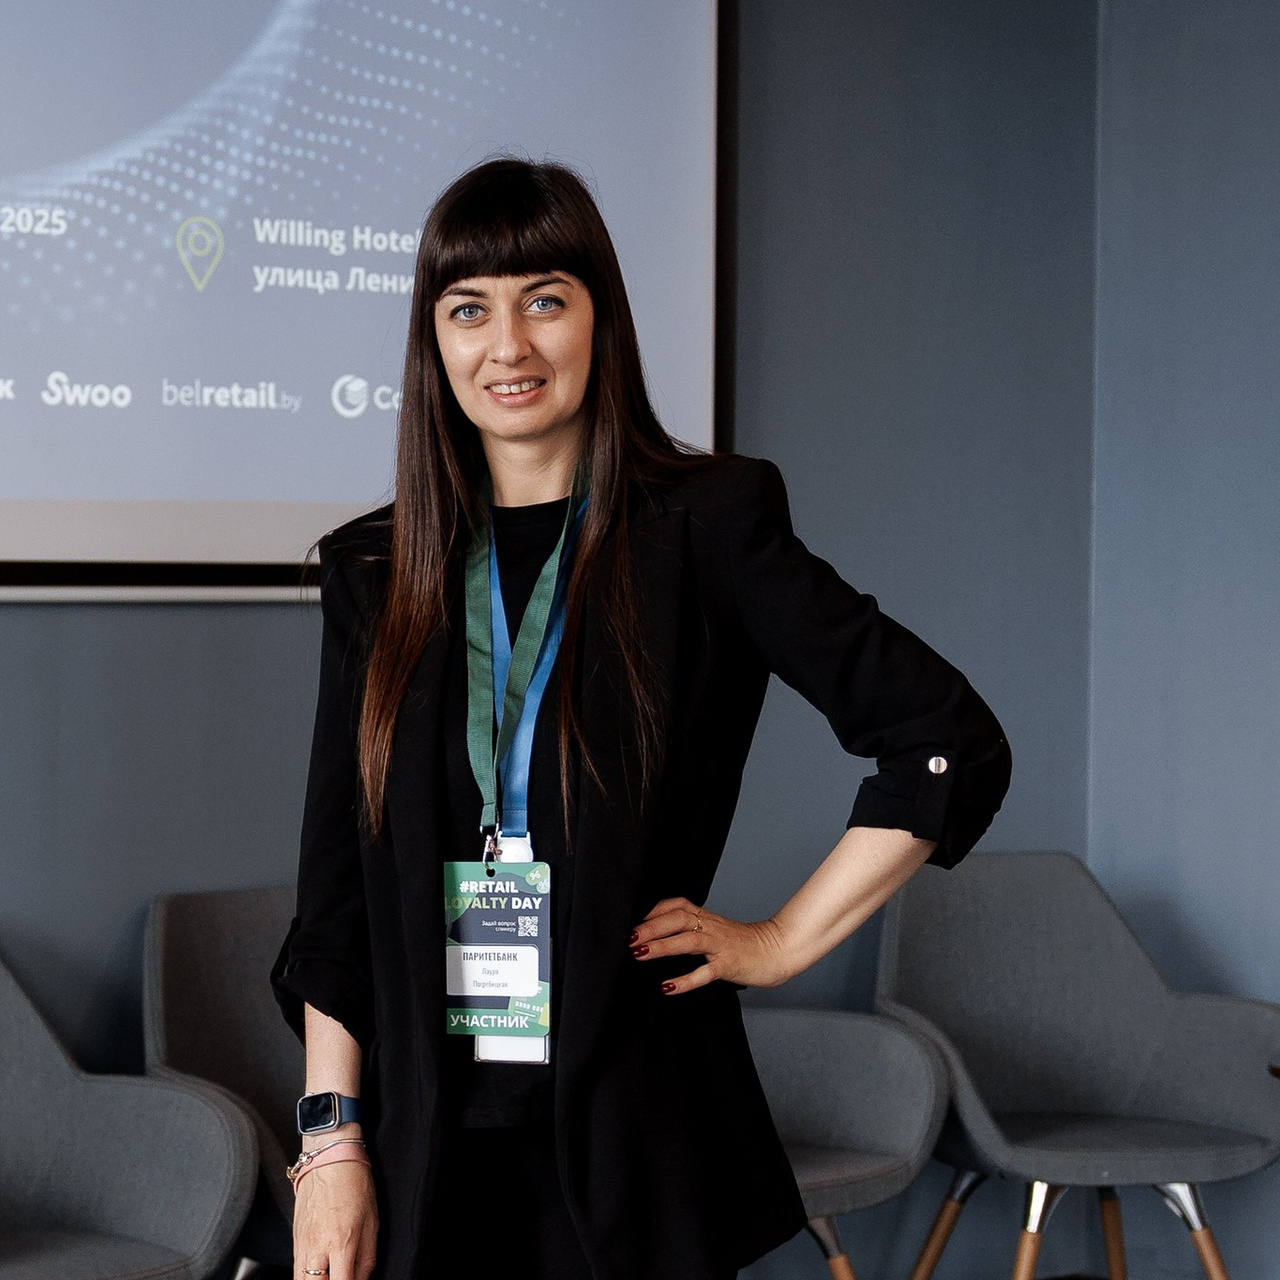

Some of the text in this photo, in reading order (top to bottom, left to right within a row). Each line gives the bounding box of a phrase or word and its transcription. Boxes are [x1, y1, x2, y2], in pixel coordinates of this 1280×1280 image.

[0, 206, 68, 236] 2025
[252, 217, 346, 257] Willing
[252, 265, 415, 296] улица Лени
[40, 370, 133, 408] Swoo
[161, 376, 303, 415] belretail.by
[459, 880, 519, 894] #RETAIL
[511, 897, 543, 910] DAY
[462, 952, 518, 962] ПАРИТЕТБАНК
[449, 1014, 529, 1029] УЧАСТНИК
